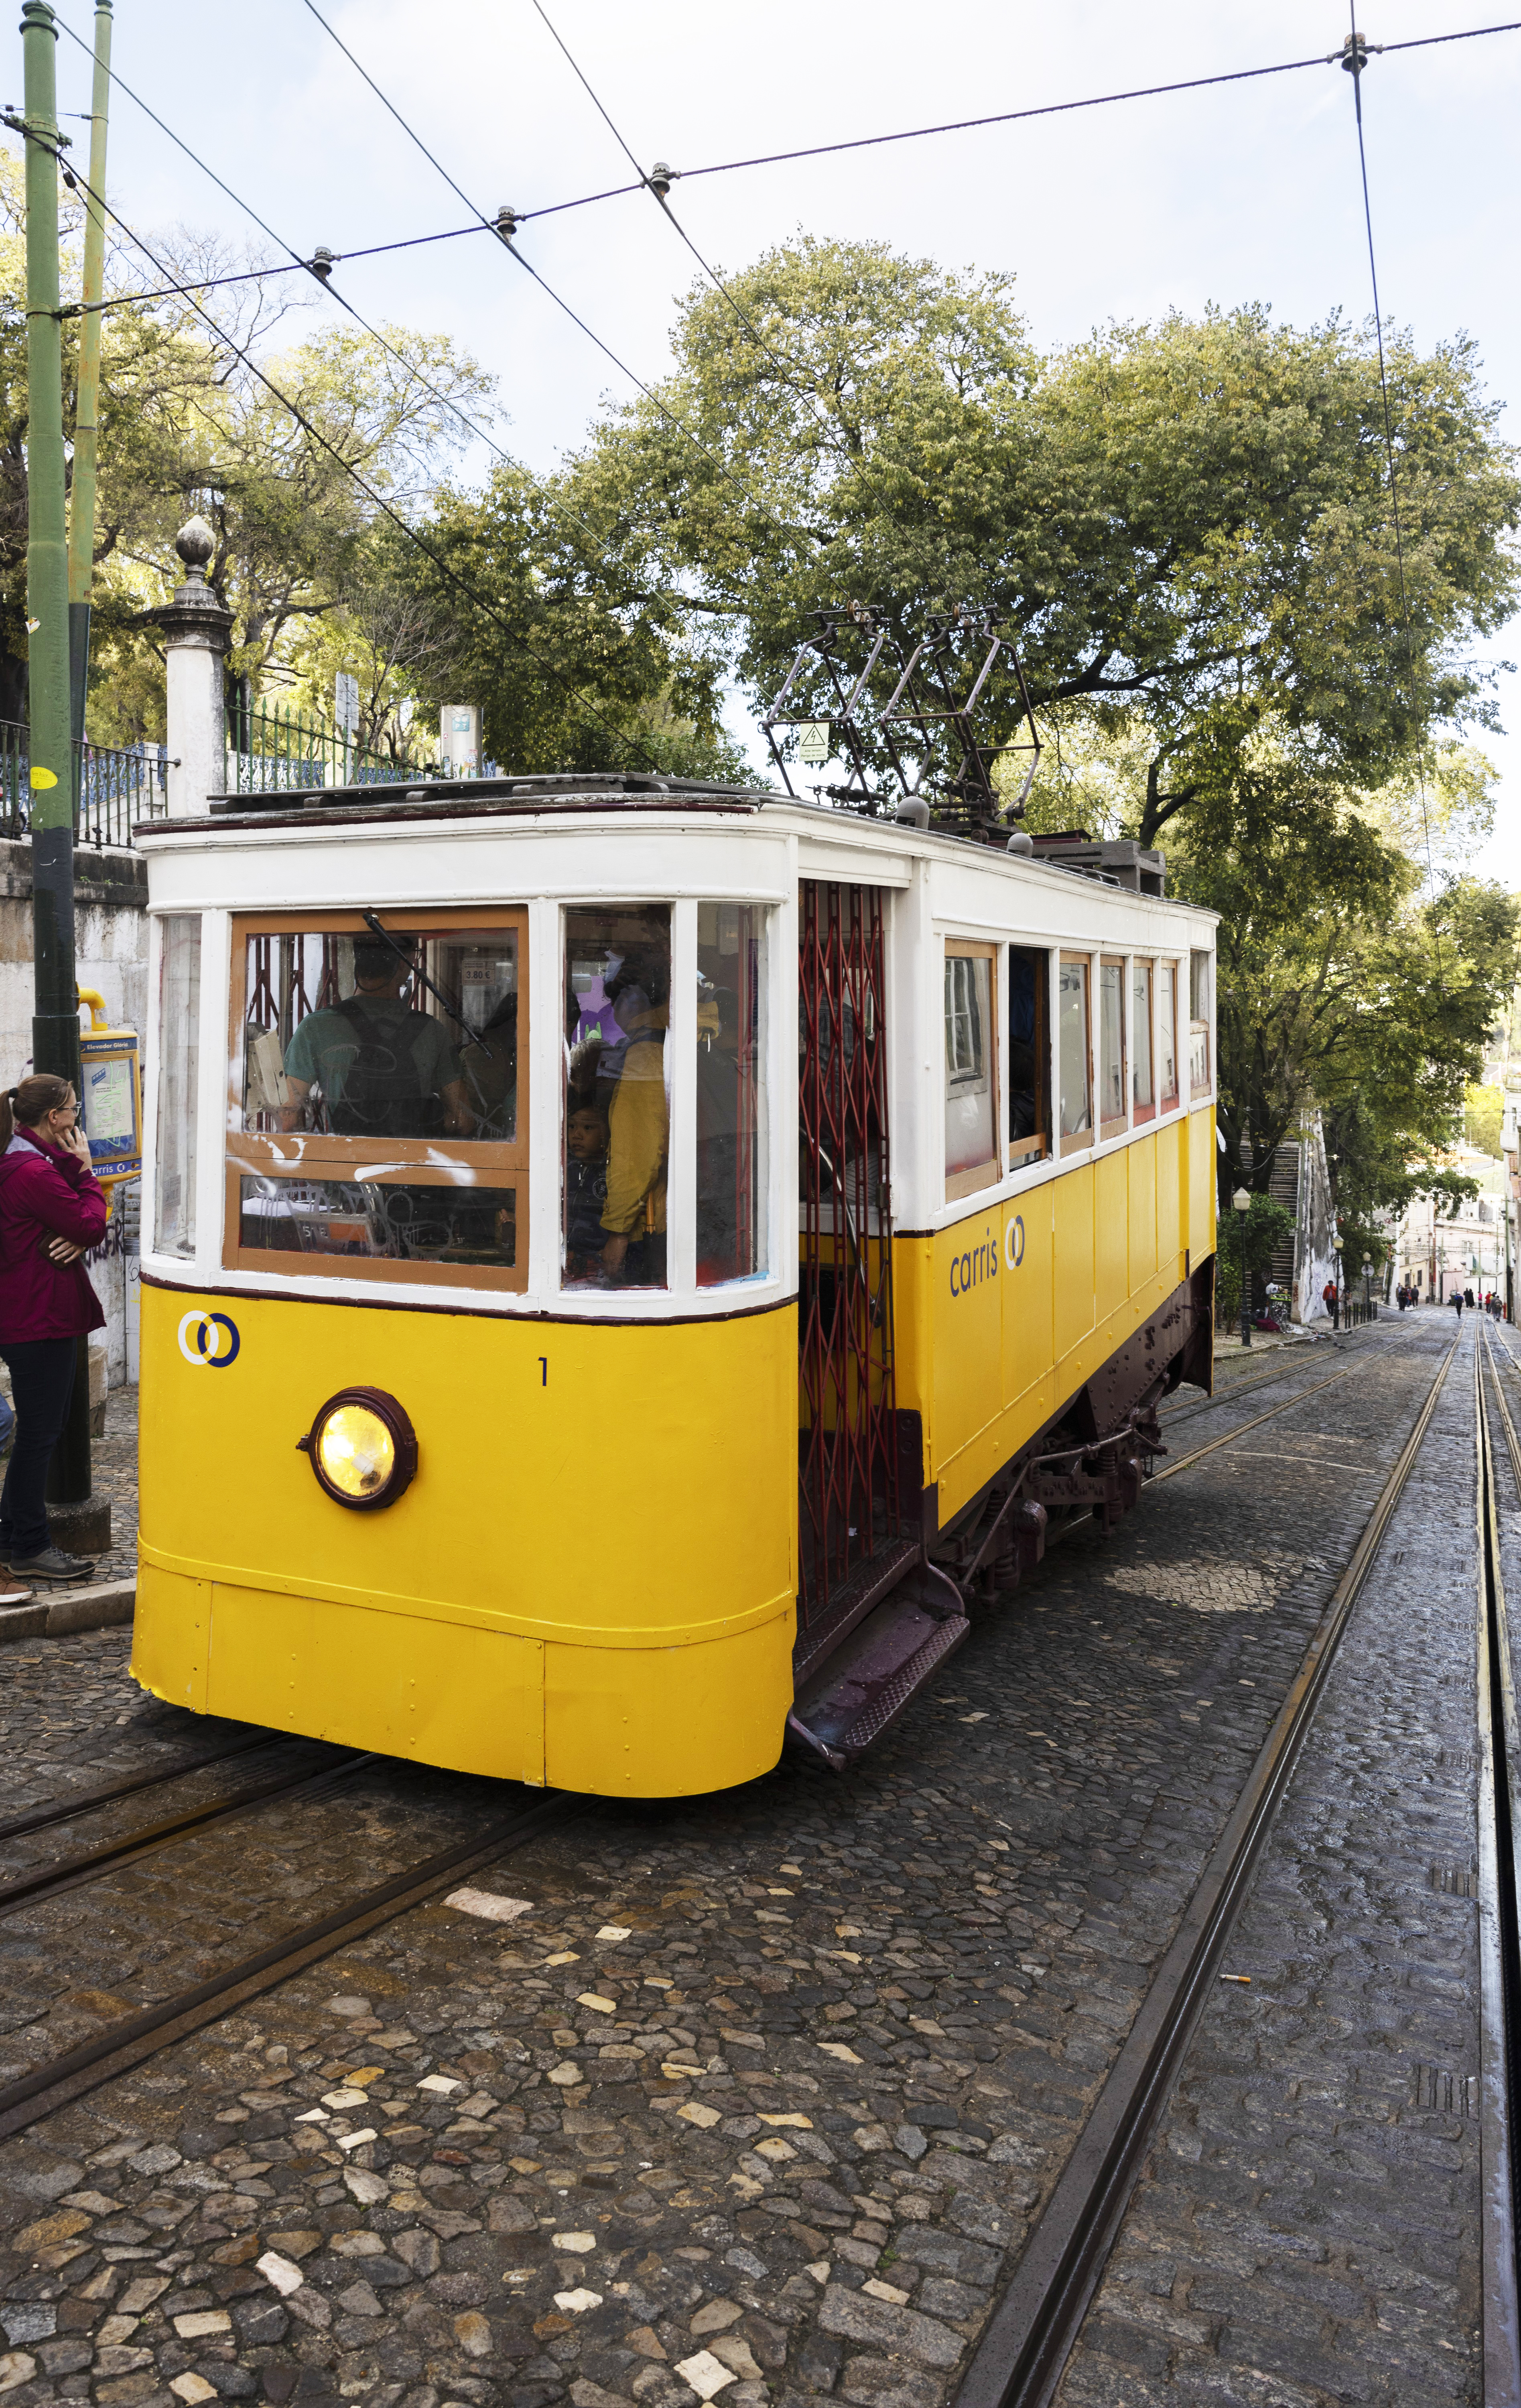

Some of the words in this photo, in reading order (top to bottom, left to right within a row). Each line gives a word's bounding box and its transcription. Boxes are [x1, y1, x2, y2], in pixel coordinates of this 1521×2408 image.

[92, 1164, 113, 1175] arris
[950, 1227, 997, 1297] carris
[537, 1356, 548, 1387] 1
